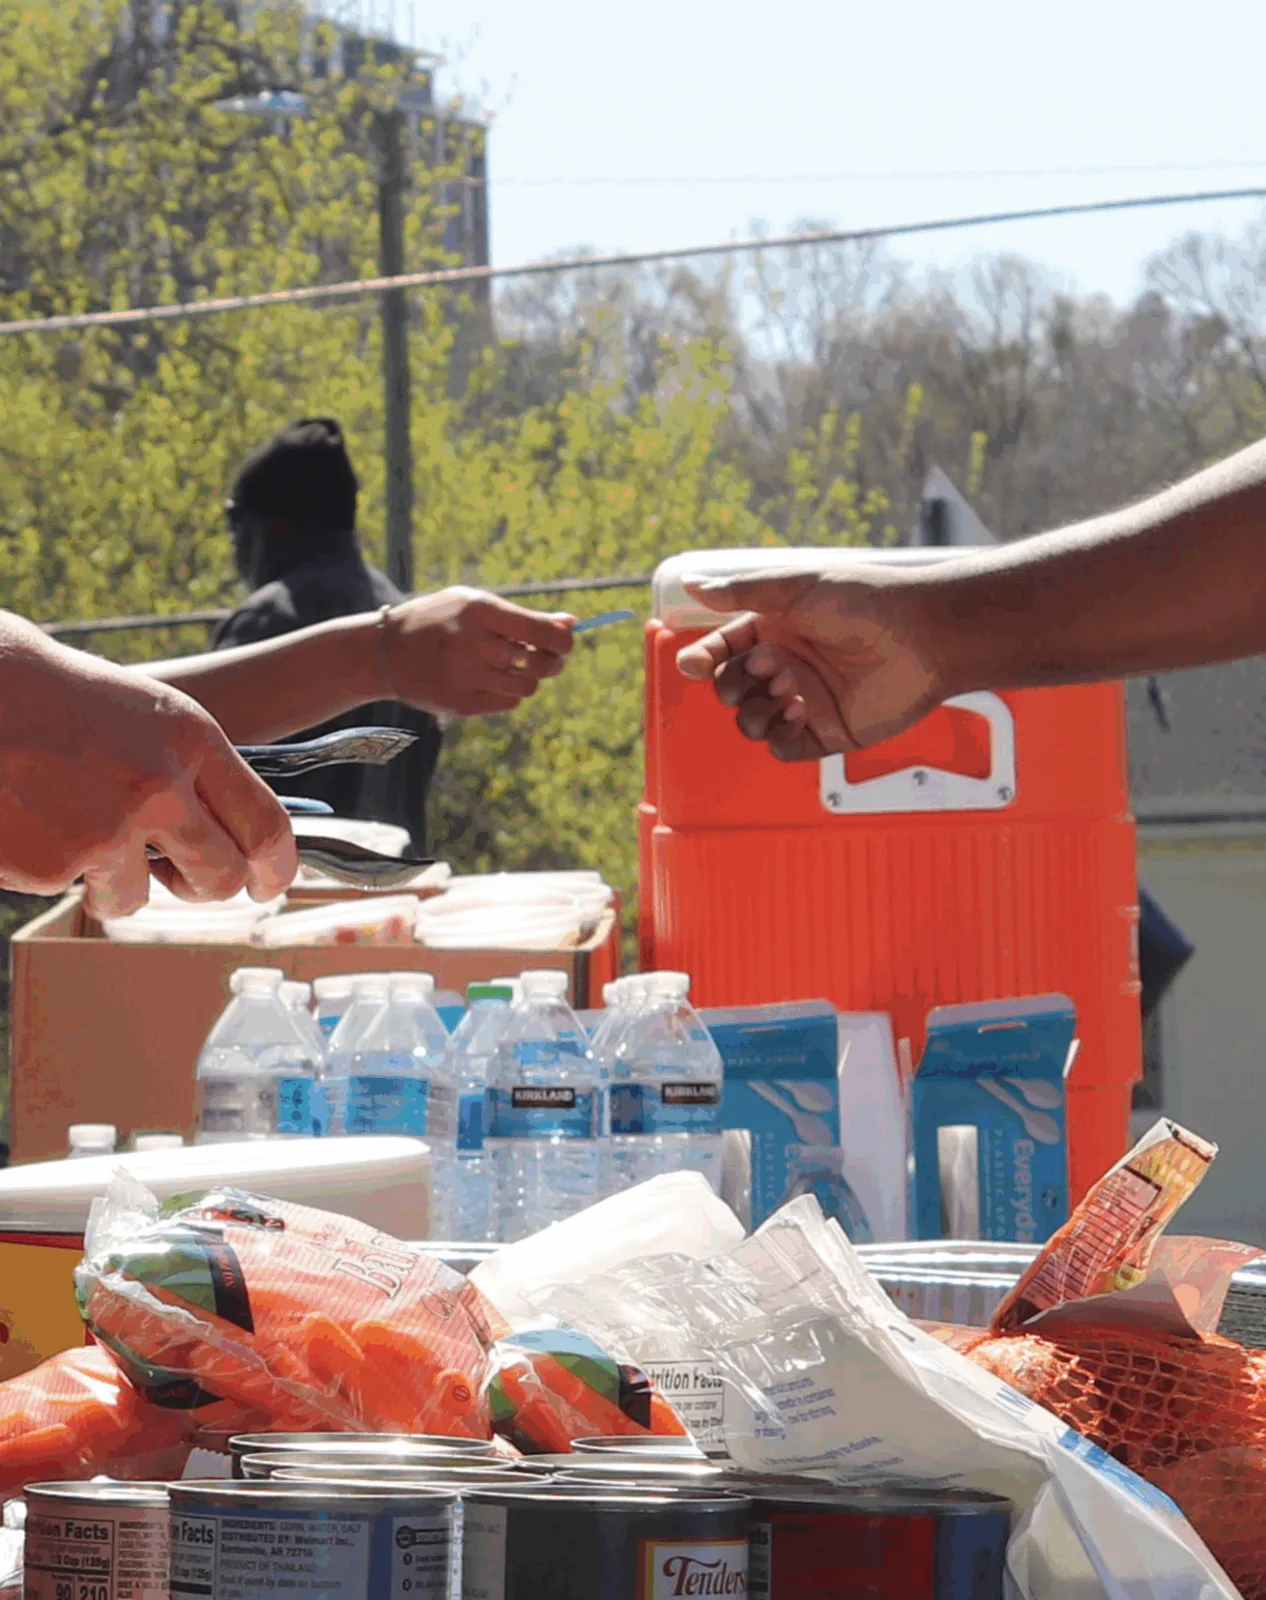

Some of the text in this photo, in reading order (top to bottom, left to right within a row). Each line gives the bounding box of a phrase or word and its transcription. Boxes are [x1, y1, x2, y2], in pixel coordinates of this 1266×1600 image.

[515, 1090, 573, 1101] KIRKLAND
[64, 1521, 109, 1541] Facts
[181, 1521, 214, 1544] Facts
[79, 1584, 108, 1600] 210
